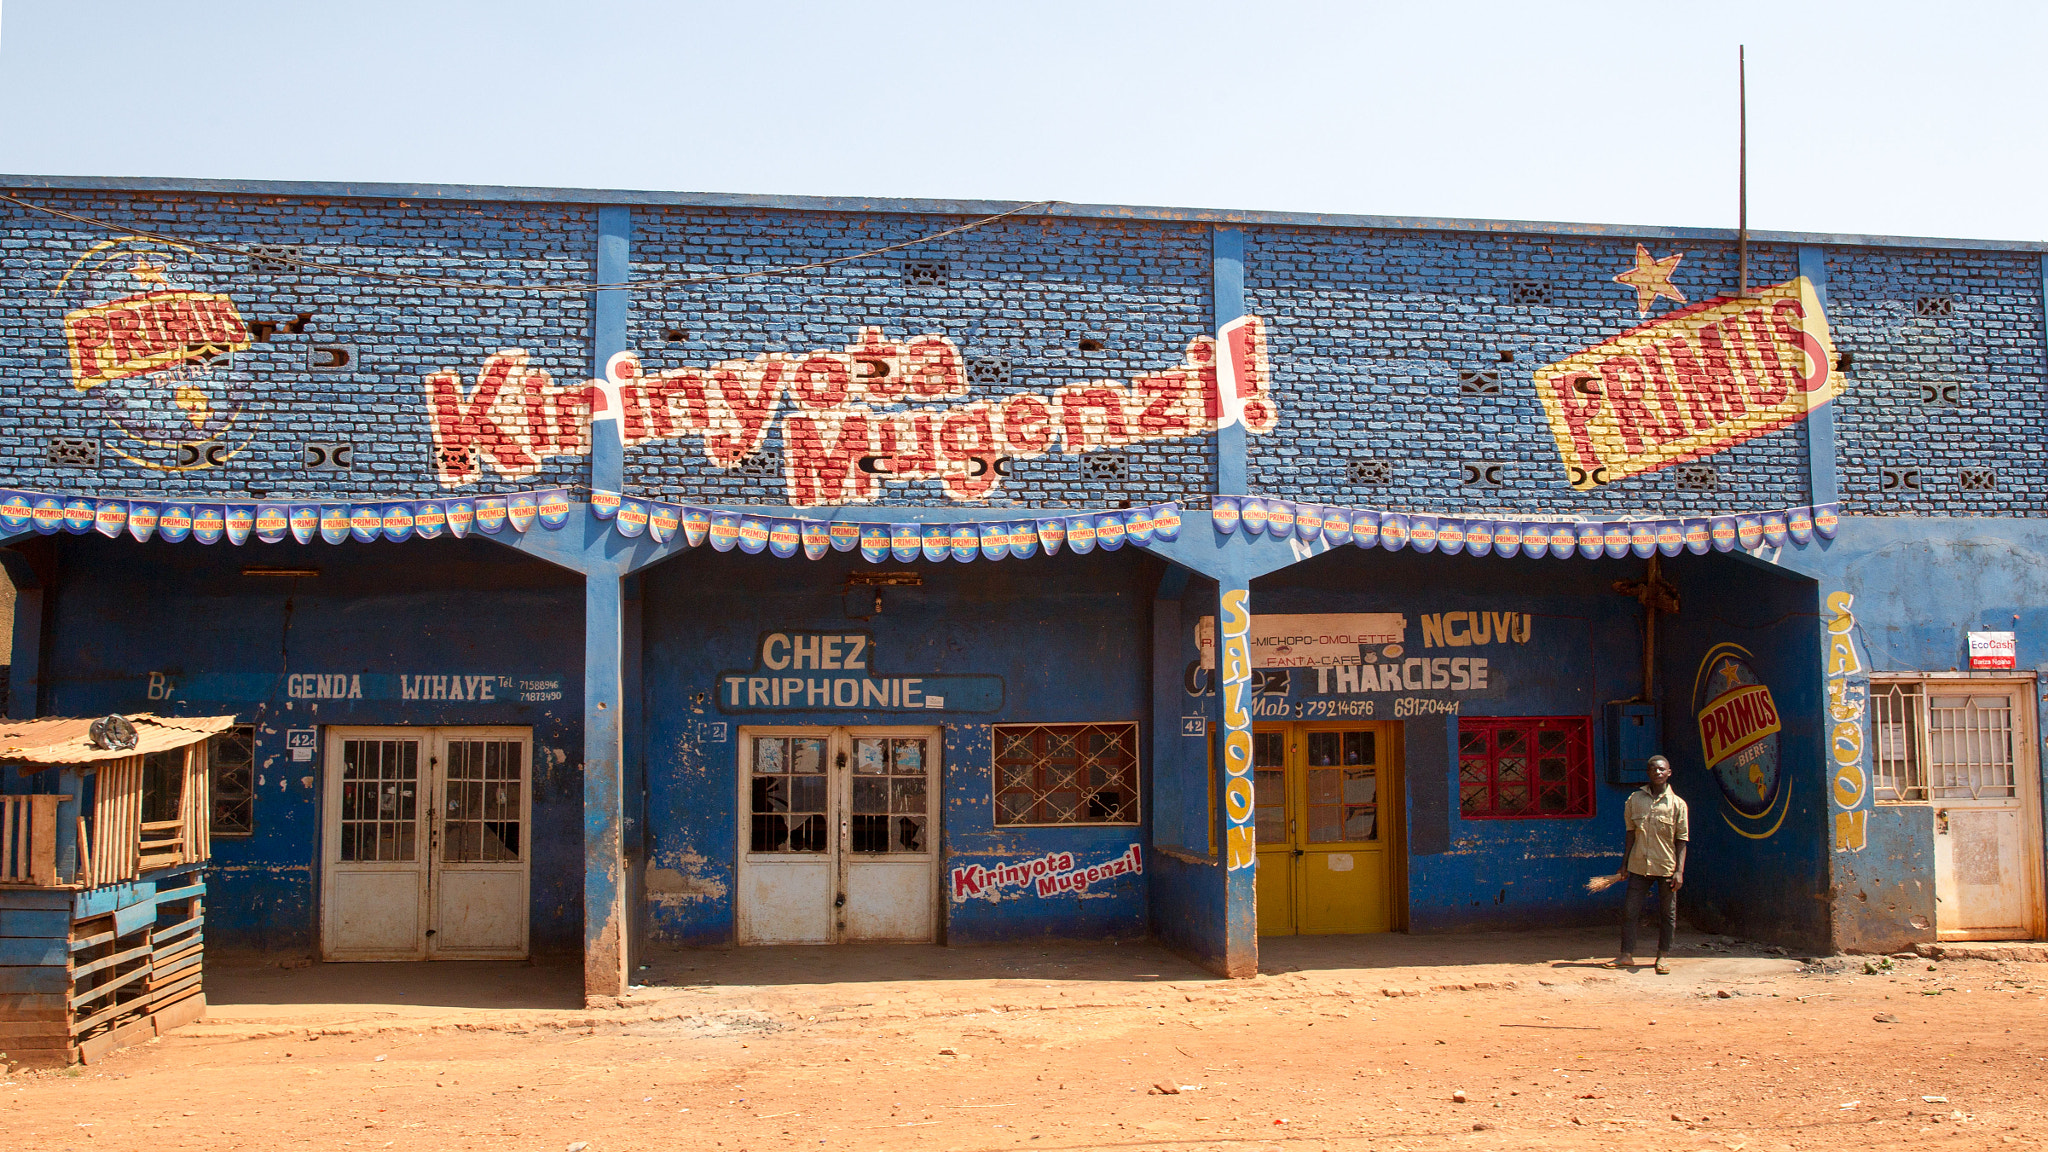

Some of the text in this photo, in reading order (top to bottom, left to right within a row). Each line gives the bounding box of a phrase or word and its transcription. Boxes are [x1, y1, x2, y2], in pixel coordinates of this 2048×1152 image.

[72, 299, 247, 379] PRIMUS
[1550, 299, 1829, 472] PRIMUS
[431, 327, 966, 480] Kirinyota
[787, 319, 1274, 503] Mugenzi!
[593, 495, 620, 506] PRIMUS
[3, 508, 31, 516] PRIMUS
[478, 509, 505, 518] PRIMUS
[510, 507, 536, 517] PRIMUS
[541, 504, 567, 514] PRIMUS
[34, 510, 63, 518] PRIMUS
[65, 510, 94, 519] PRIMUS
[99, 513, 127, 522] PRIMUS
[620, 512, 647, 522] PRIMUS
[1214, 511, 1237, 519] PRIMUS
[1244, 511, 1266, 519] PRIMUS
[1269, 514, 1292, 522] PRIMUS
[162, 518, 190, 527] PRIMUS
[258, 519, 286, 527] PRIMUS
[292, 519, 318, 527] PRIMUS
[323, 519, 350, 528] PRIMUS
[352, 518, 380, 527] PRIMUS
[385, 518, 412, 526] PRIMUS
[417, 515, 444, 524] PRIMUS
[652, 517, 677, 528] PRIMUS
[1154, 518, 1179, 527] PRIMUS
[1298, 517, 1321, 526] PRIMUS
[1816, 516, 1837, 525] PRIMUS
[195, 521, 223, 529] PRIMUS
[685, 522, 709, 531] PRIMUS
[1128, 521, 1153, 532] PRIMUS
[1325, 522, 1348, 531] PRIMUS
[1354, 525, 1377, 534] PRIMUS
[1764, 524, 1786, 533] PRIMUS
[1790, 521, 1811, 530] PRIMUS
[712, 526, 738, 536] PRIMUS
[742, 528, 767, 539] PRIMUS
[832, 527, 858, 535] PRIMUS
[1041, 531, 1064, 539] PRIMUS
[1069, 529, 1094, 539] PRIMUS
[1098, 526, 1123, 536] PRIMUS
[1412, 530, 1434, 538] PRIMUS
[1714, 530, 1734, 538] PRIMUS
[772, 533, 798, 542] PRIMUS
[804, 535, 829, 544] PRIMUS
[983, 536, 1008, 545] PRIMUS
[1011, 534, 1036, 543] PRIMUS
[1440, 532, 1462, 540] PRIMUS
[1468, 534, 1491, 542] PRIMUS
[1496, 535, 1518, 543] PRIMUS
[1524, 536, 1547, 544] PRIMUS
[1552, 536, 1574, 544] PRIMUS
[1605, 536, 1628, 544] PRIMUS
[1633, 535, 1655, 543] PRIMUS
[1659, 534, 1681, 543] PRIMUS
[1688, 532, 1709, 541] PRIMUS
[863, 538, 889, 547] PRIMUS
[893, 538, 919, 546] PRIMUS
[923, 538, 950, 546] PRIMUS
[952, 538, 978, 547] PRIMUS
[1580, 537, 1602, 545] PRIMUS
[1421, 611, 1532, 648] NGUVU
[1971, 640, 2013, 649] EcoCash
[762, 633, 866, 671] CHEZ
[1312, 657, 1488, 694] THARCISSE
[288, 673, 362, 699] GENDA
[401, 674, 496, 700] WIHAYE
[519, 680, 559, 691] 71588946
[520, 691, 562, 701] 71873490
[725, 676, 924, 708] TRIPHONIE
[1307, 700, 1374, 717] 79214676
[1185, 720, 1203, 732] 42
[1701, 689, 1776, 761] PRIMUS
[1222, 589, 1256, 872] SALOON
[954, 853, 1072, 897] Kirinyota
[1038, 845, 1142, 896] Mugenzi!
